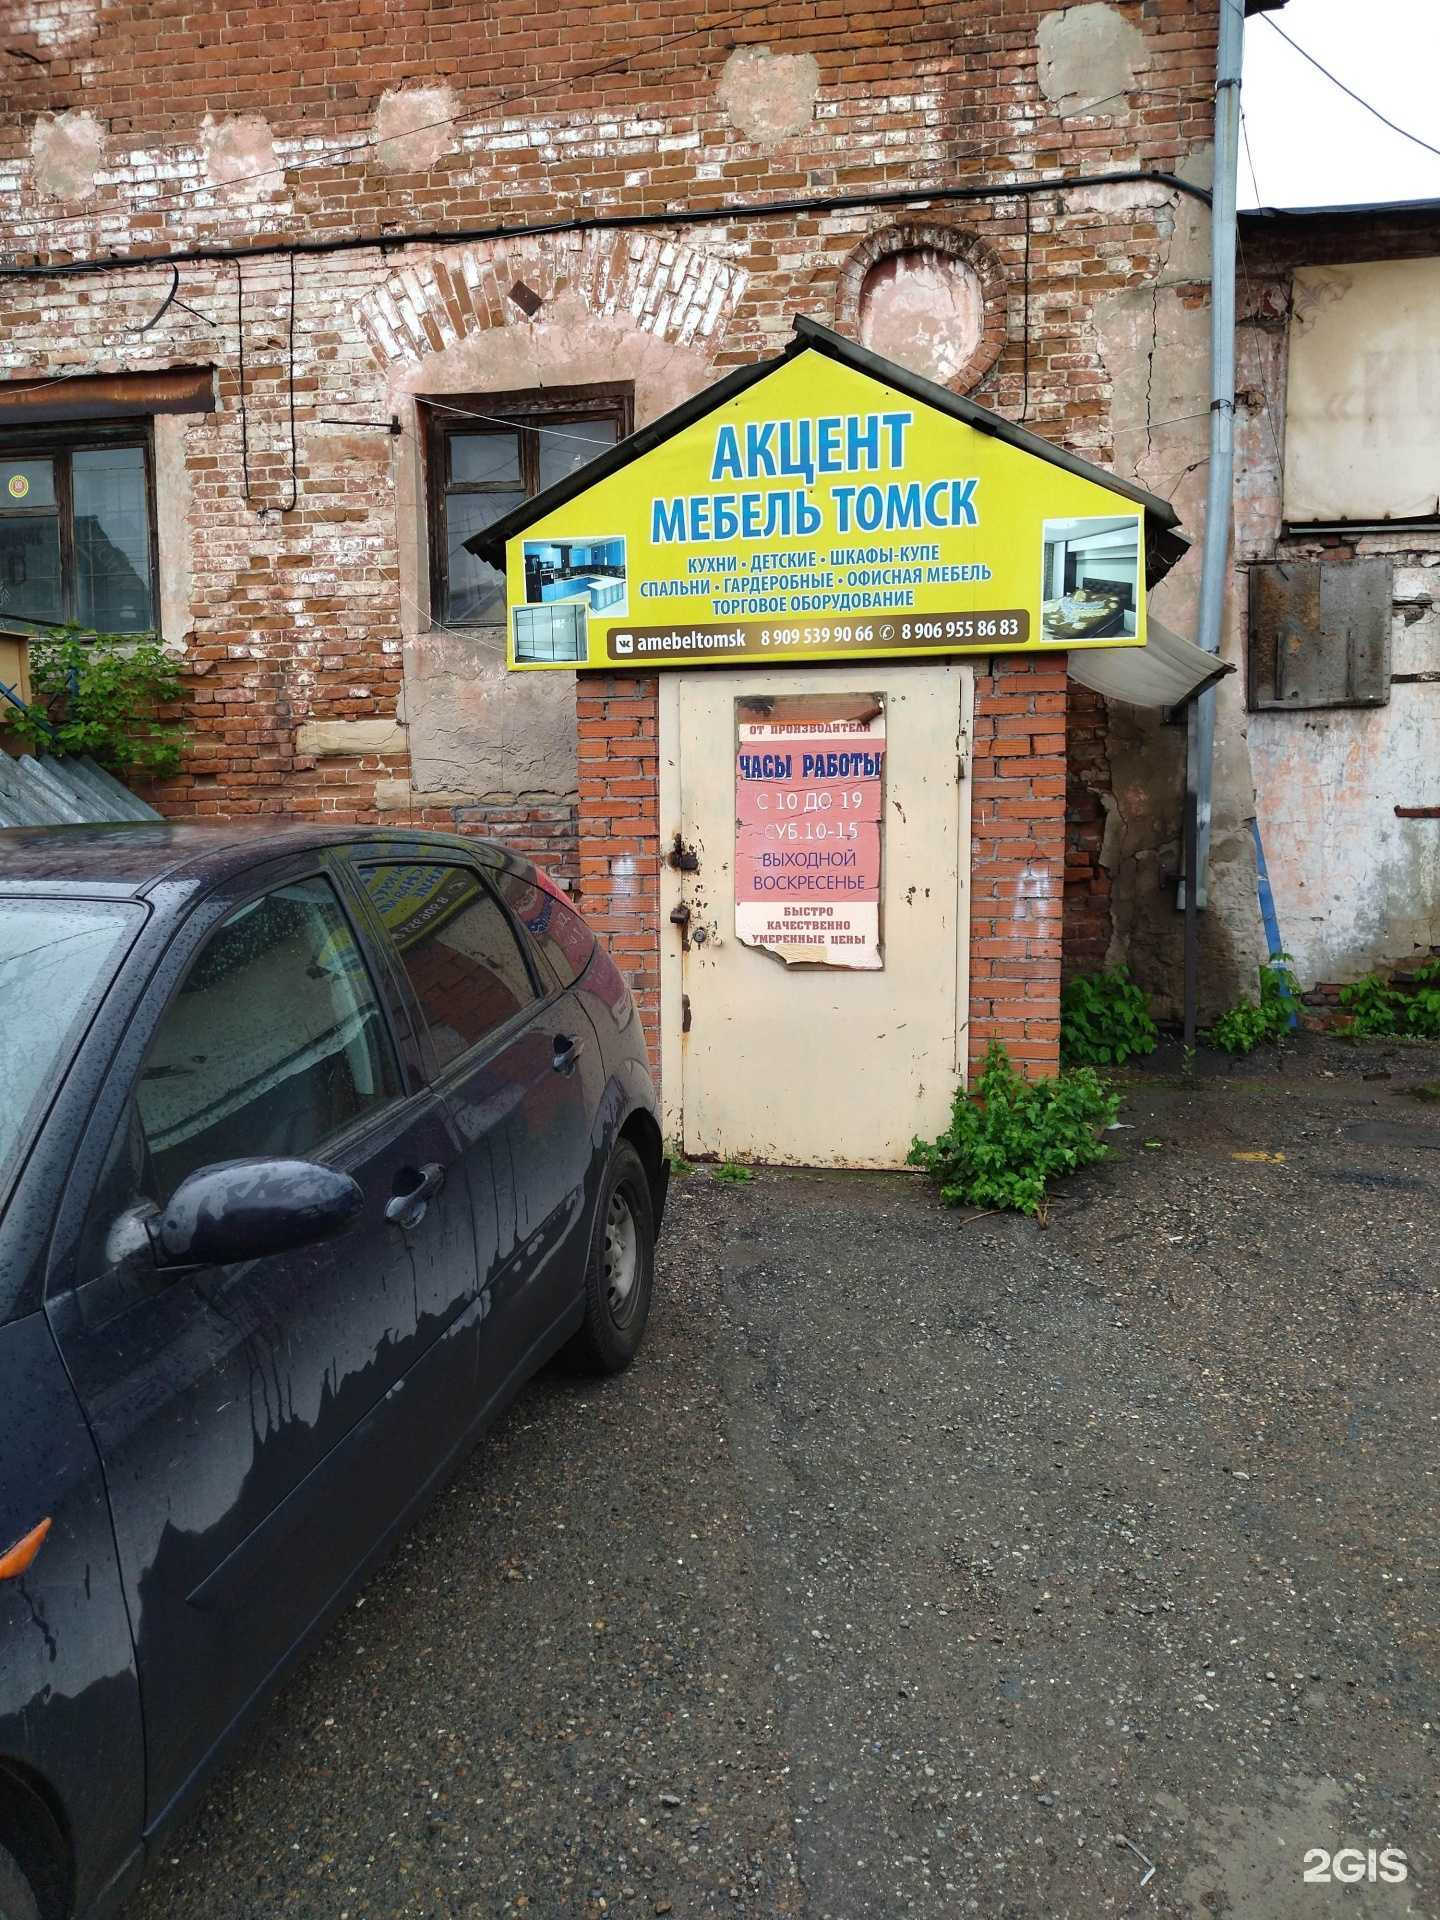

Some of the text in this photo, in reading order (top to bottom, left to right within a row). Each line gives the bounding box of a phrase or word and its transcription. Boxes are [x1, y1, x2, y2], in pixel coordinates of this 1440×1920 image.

[711, 413, 912, 484] АКЦЕНТ
[652, 480, 978, 543] МЕБЕЛЬ ТОМСК
[688, 545, 940, 573] КУХНИ ДЕТСКИЕ ШКАФЫ-КУПЕ
[640, 565, 992, 597] СПАЛЬНИ ГАРДЕРОБНЫЕ ОФИСНАЯ МЕБЕЛЬ
[713, 590, 914, 615] ТОРГОВОЕ ОБОРУДОВАНИЕ
[637, 630, 746, 651] amebeltomsk
[761, 630, 770, 645] 8
[773, 629, 800, 645] 909
[803, 628, 831, 644] 539
[833, 627, 852, 643] 90
[855, 625, 874, 641] 66
[901, 625, 911, 640] 8
[914, 623, 942, 639] 906
[946, 621, 974, 637] 955
[977, 620, 996, 636] 86
[999, 619, 1018, 635] 83
[750, 726, 764, 735] ОТ
[740, 752, 880, 780] ЧАСЫ РАБОТЫ
[757, 792, 862, 811] С 10 ДО 19
[762, 849, 856, 868] ВЫХОДНОЙ
[754, 875, 865, 890] ВОСКРЕСЕНЬЕ
[784, 907, 834, 917] БЫСТРО
[767, 921, 851, 930] КАЧЕСТВЕННО
[752, 934, 866, 945] УМЕРЕННЫЕ ЦЕНЫ
